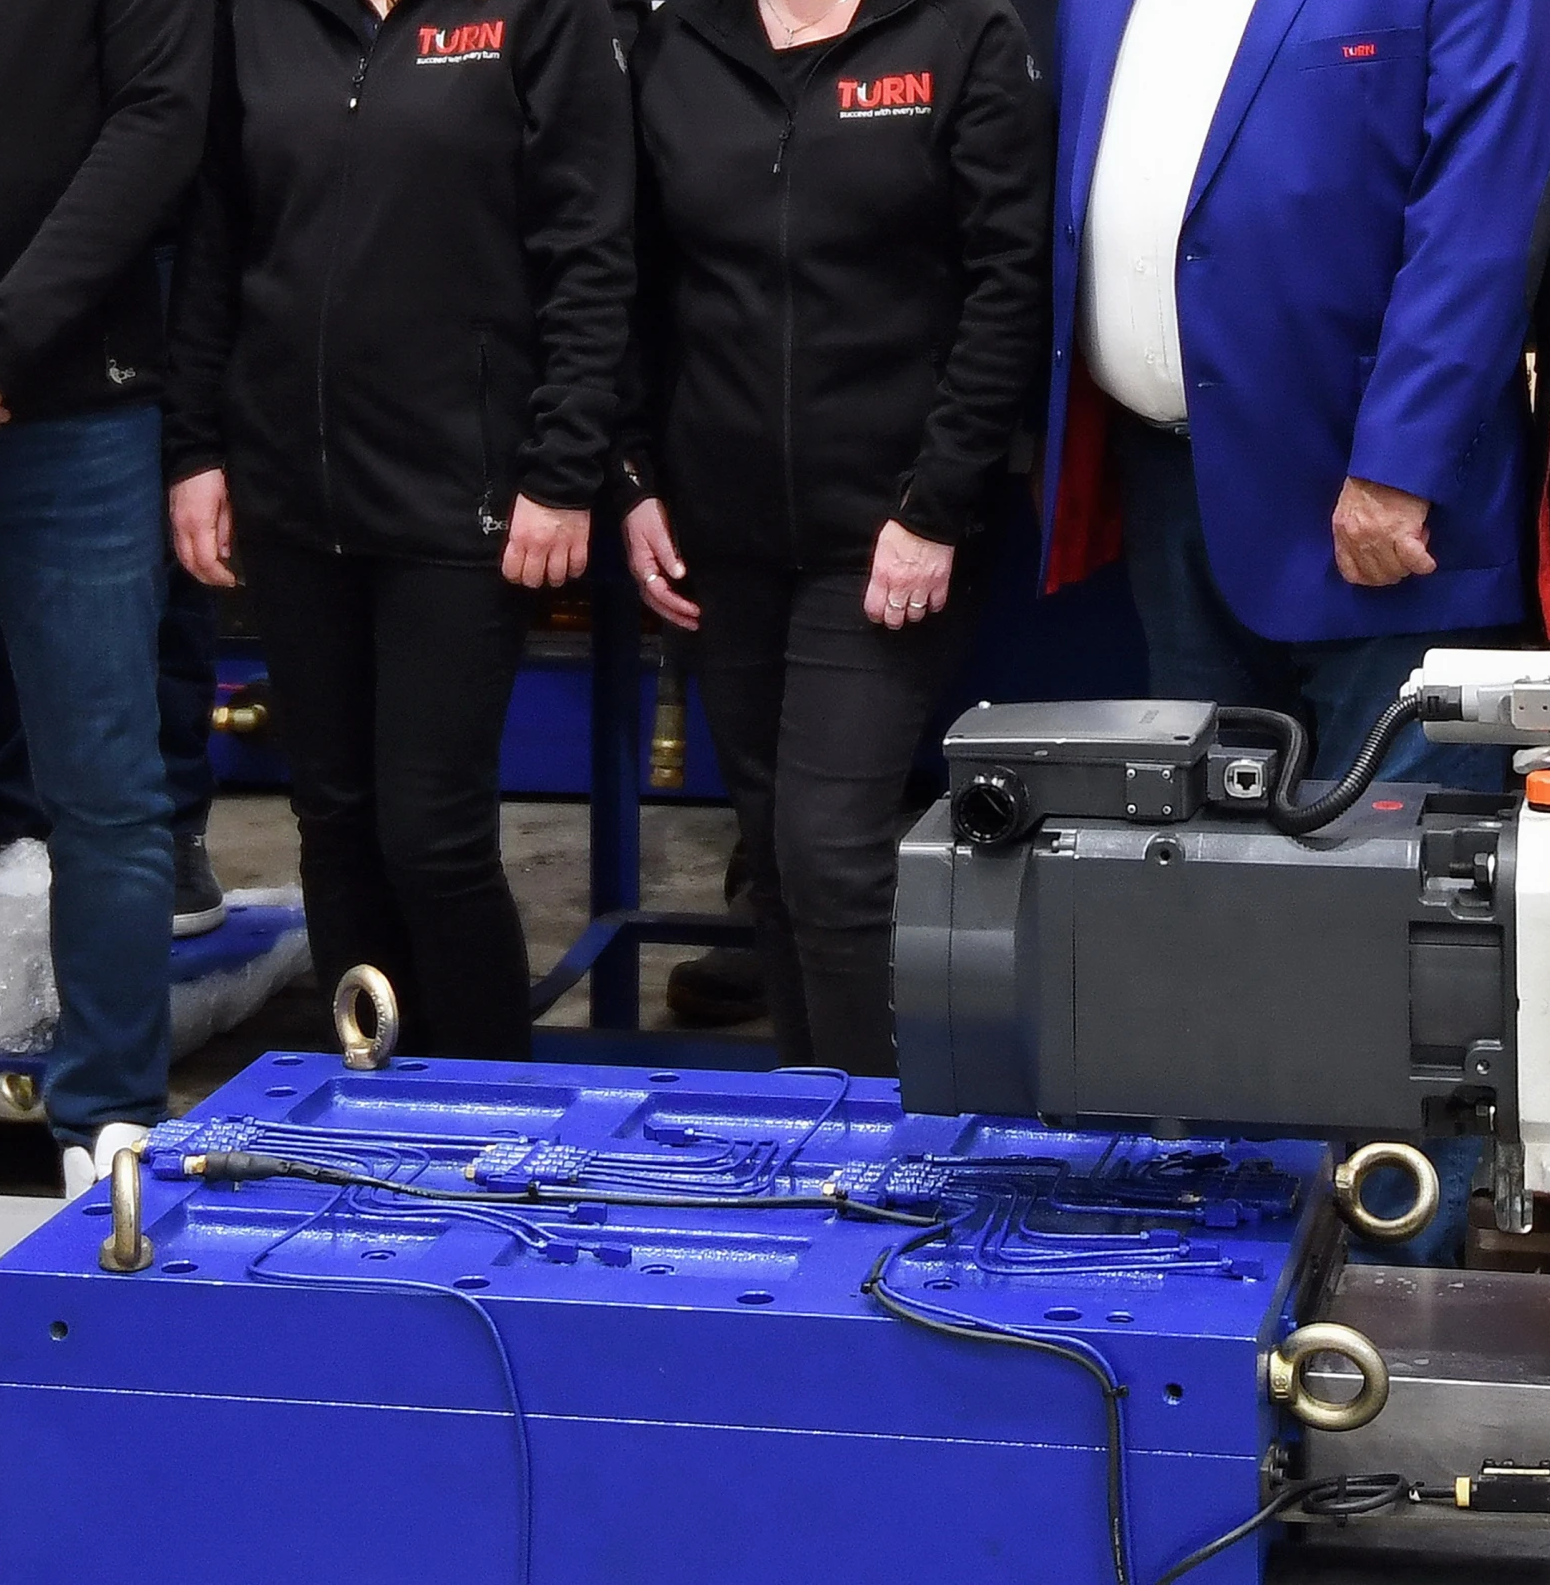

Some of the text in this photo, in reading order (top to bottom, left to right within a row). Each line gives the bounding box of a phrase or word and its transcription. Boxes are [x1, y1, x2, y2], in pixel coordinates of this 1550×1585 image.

[419, 21, 504, 55] TURN
[1342, 44, 1375, 58] TURN
[838, 72, 931, 109] TURN
